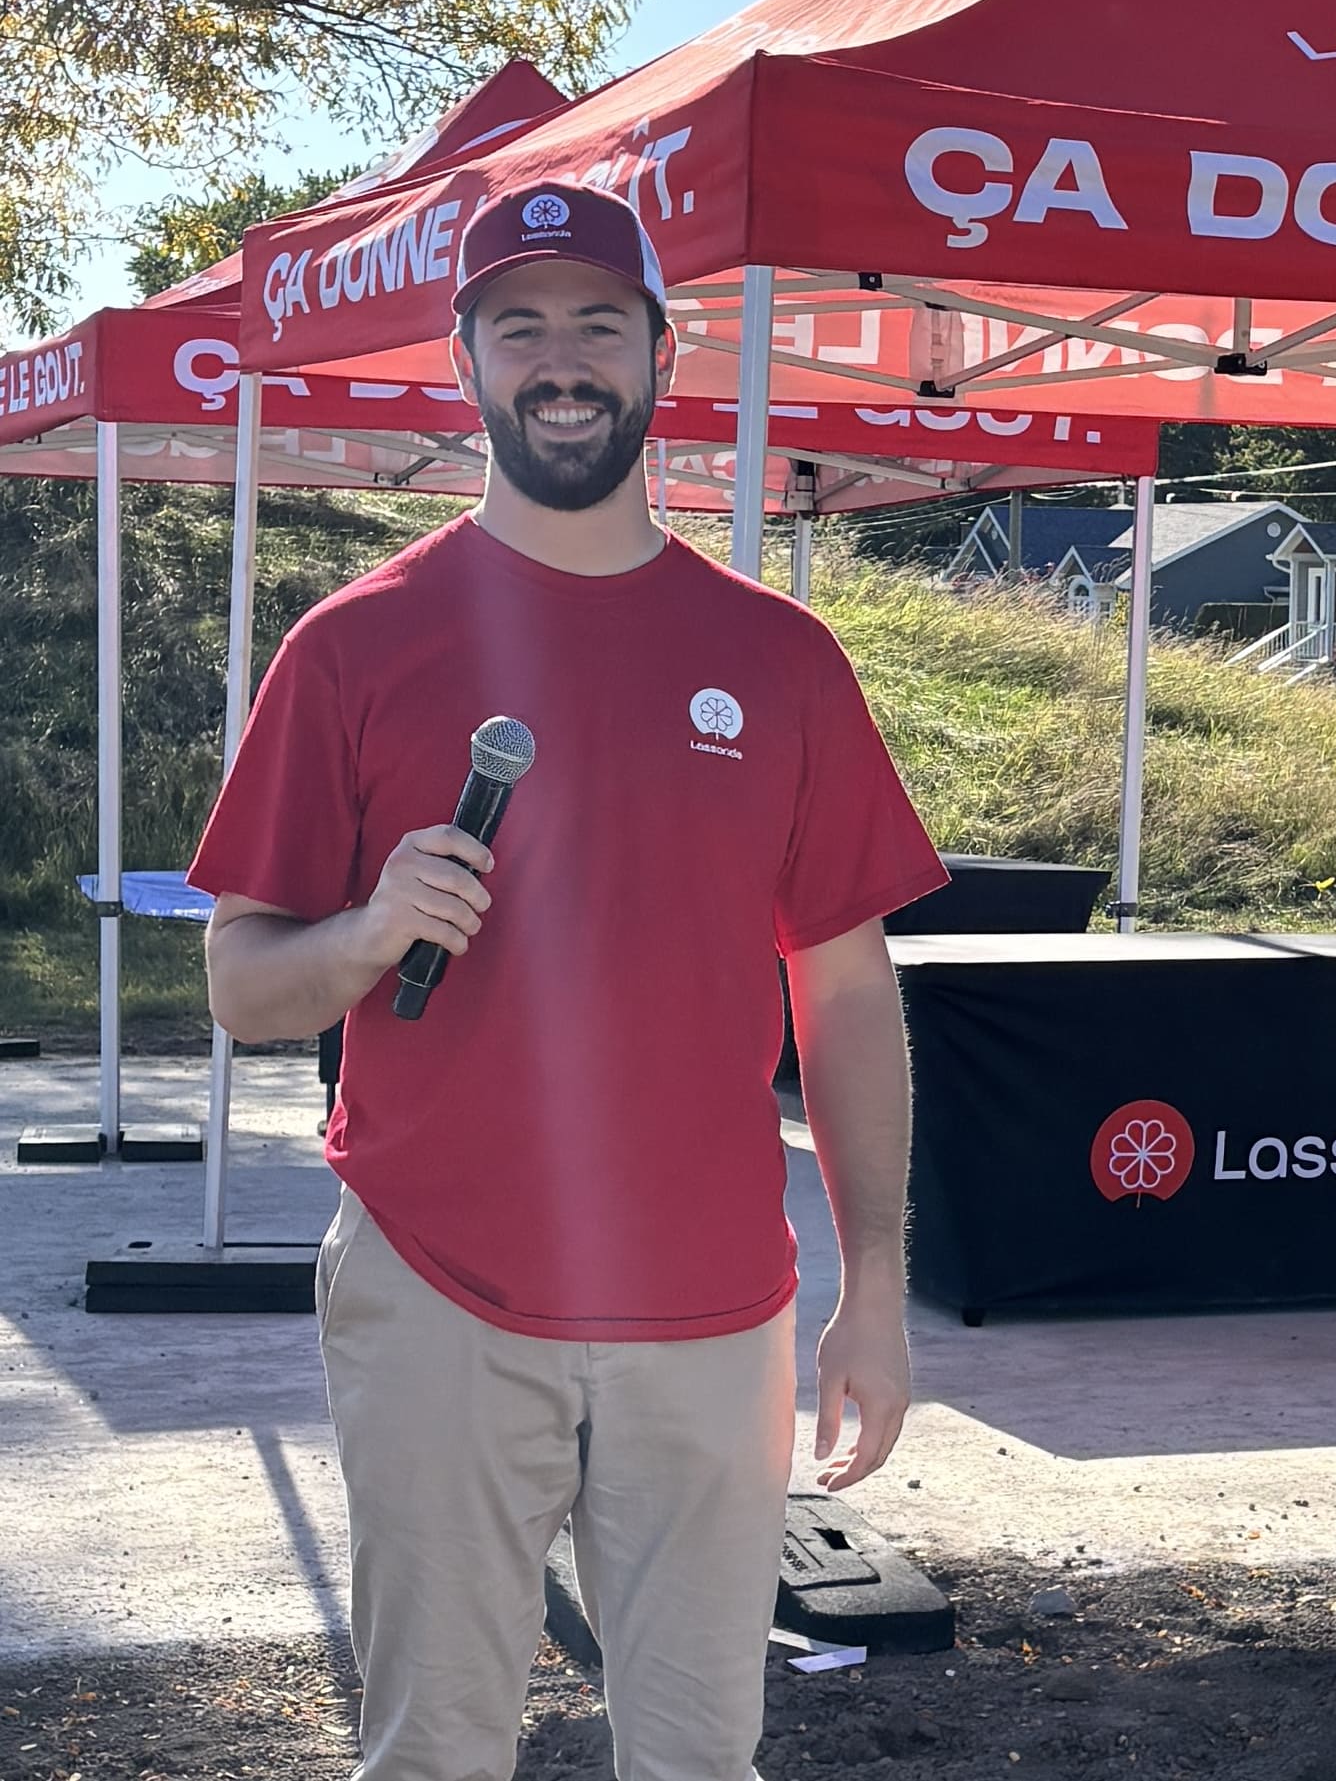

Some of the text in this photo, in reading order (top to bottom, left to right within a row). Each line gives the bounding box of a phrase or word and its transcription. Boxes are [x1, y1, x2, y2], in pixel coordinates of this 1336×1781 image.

[903, 126, 1129, 250] ÇA
[263, 249, 314, 343] ÇA
[316, 195, 463, 311] DONNE
[8, 359, 30, 414] LE
